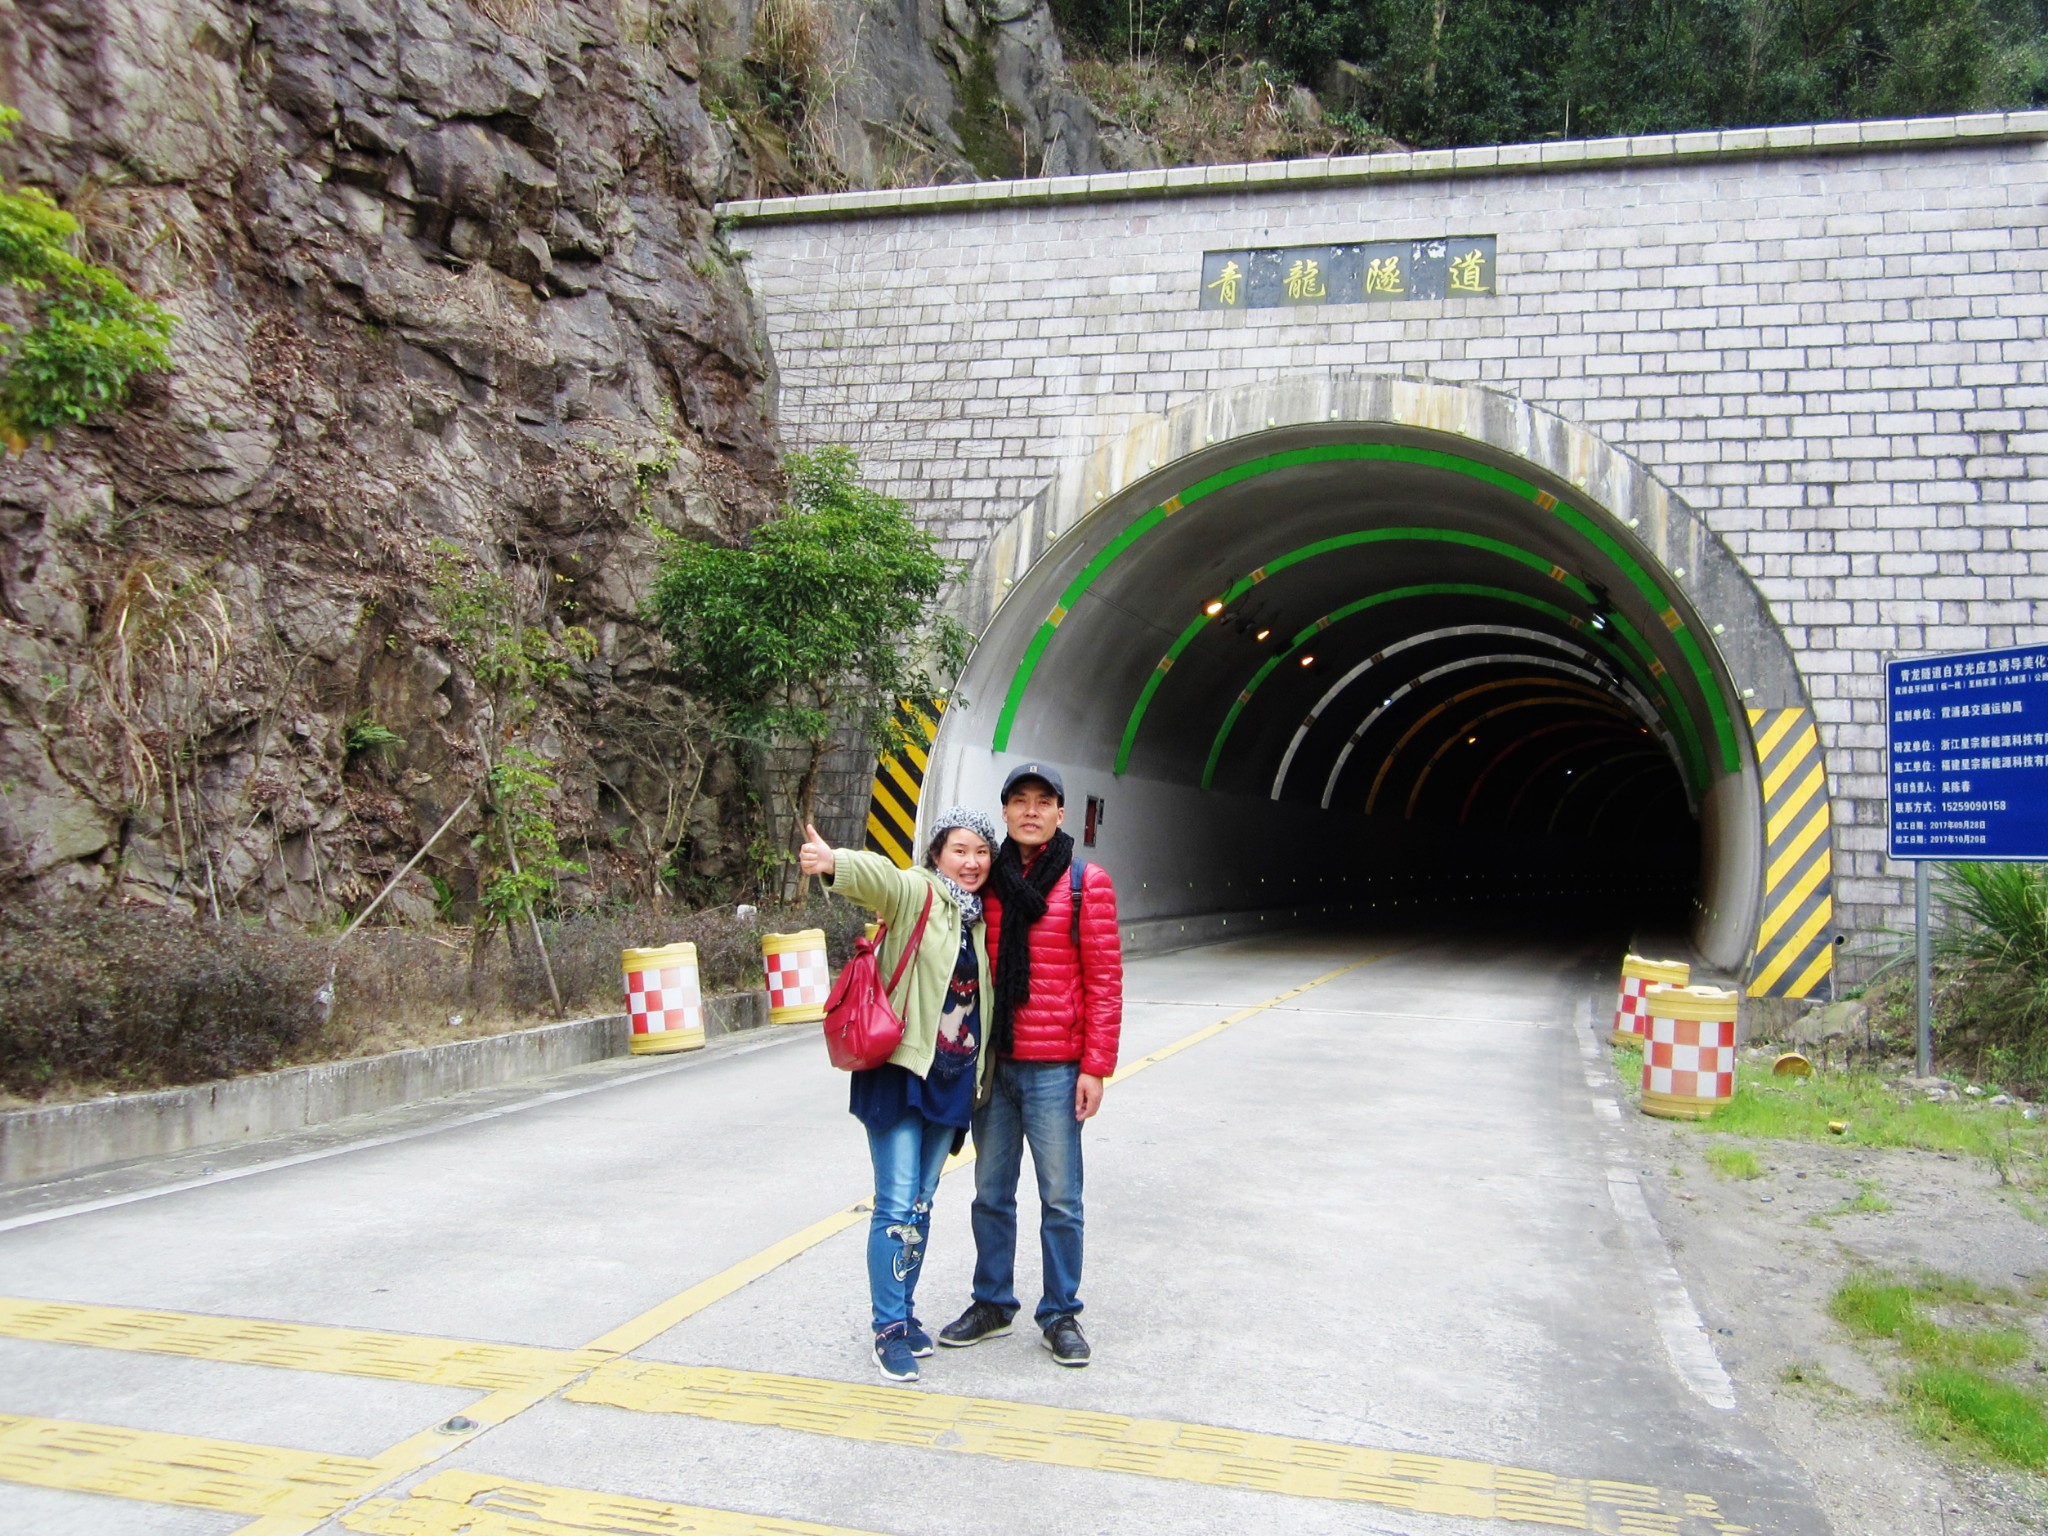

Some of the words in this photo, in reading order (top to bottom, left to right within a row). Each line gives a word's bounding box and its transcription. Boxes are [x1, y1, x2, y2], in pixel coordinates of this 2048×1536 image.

[1207, 249, 1490, 305] 青龍隧道
[1900, 654, 2048, 683] 青龙隧道自发光应急诱导美化
